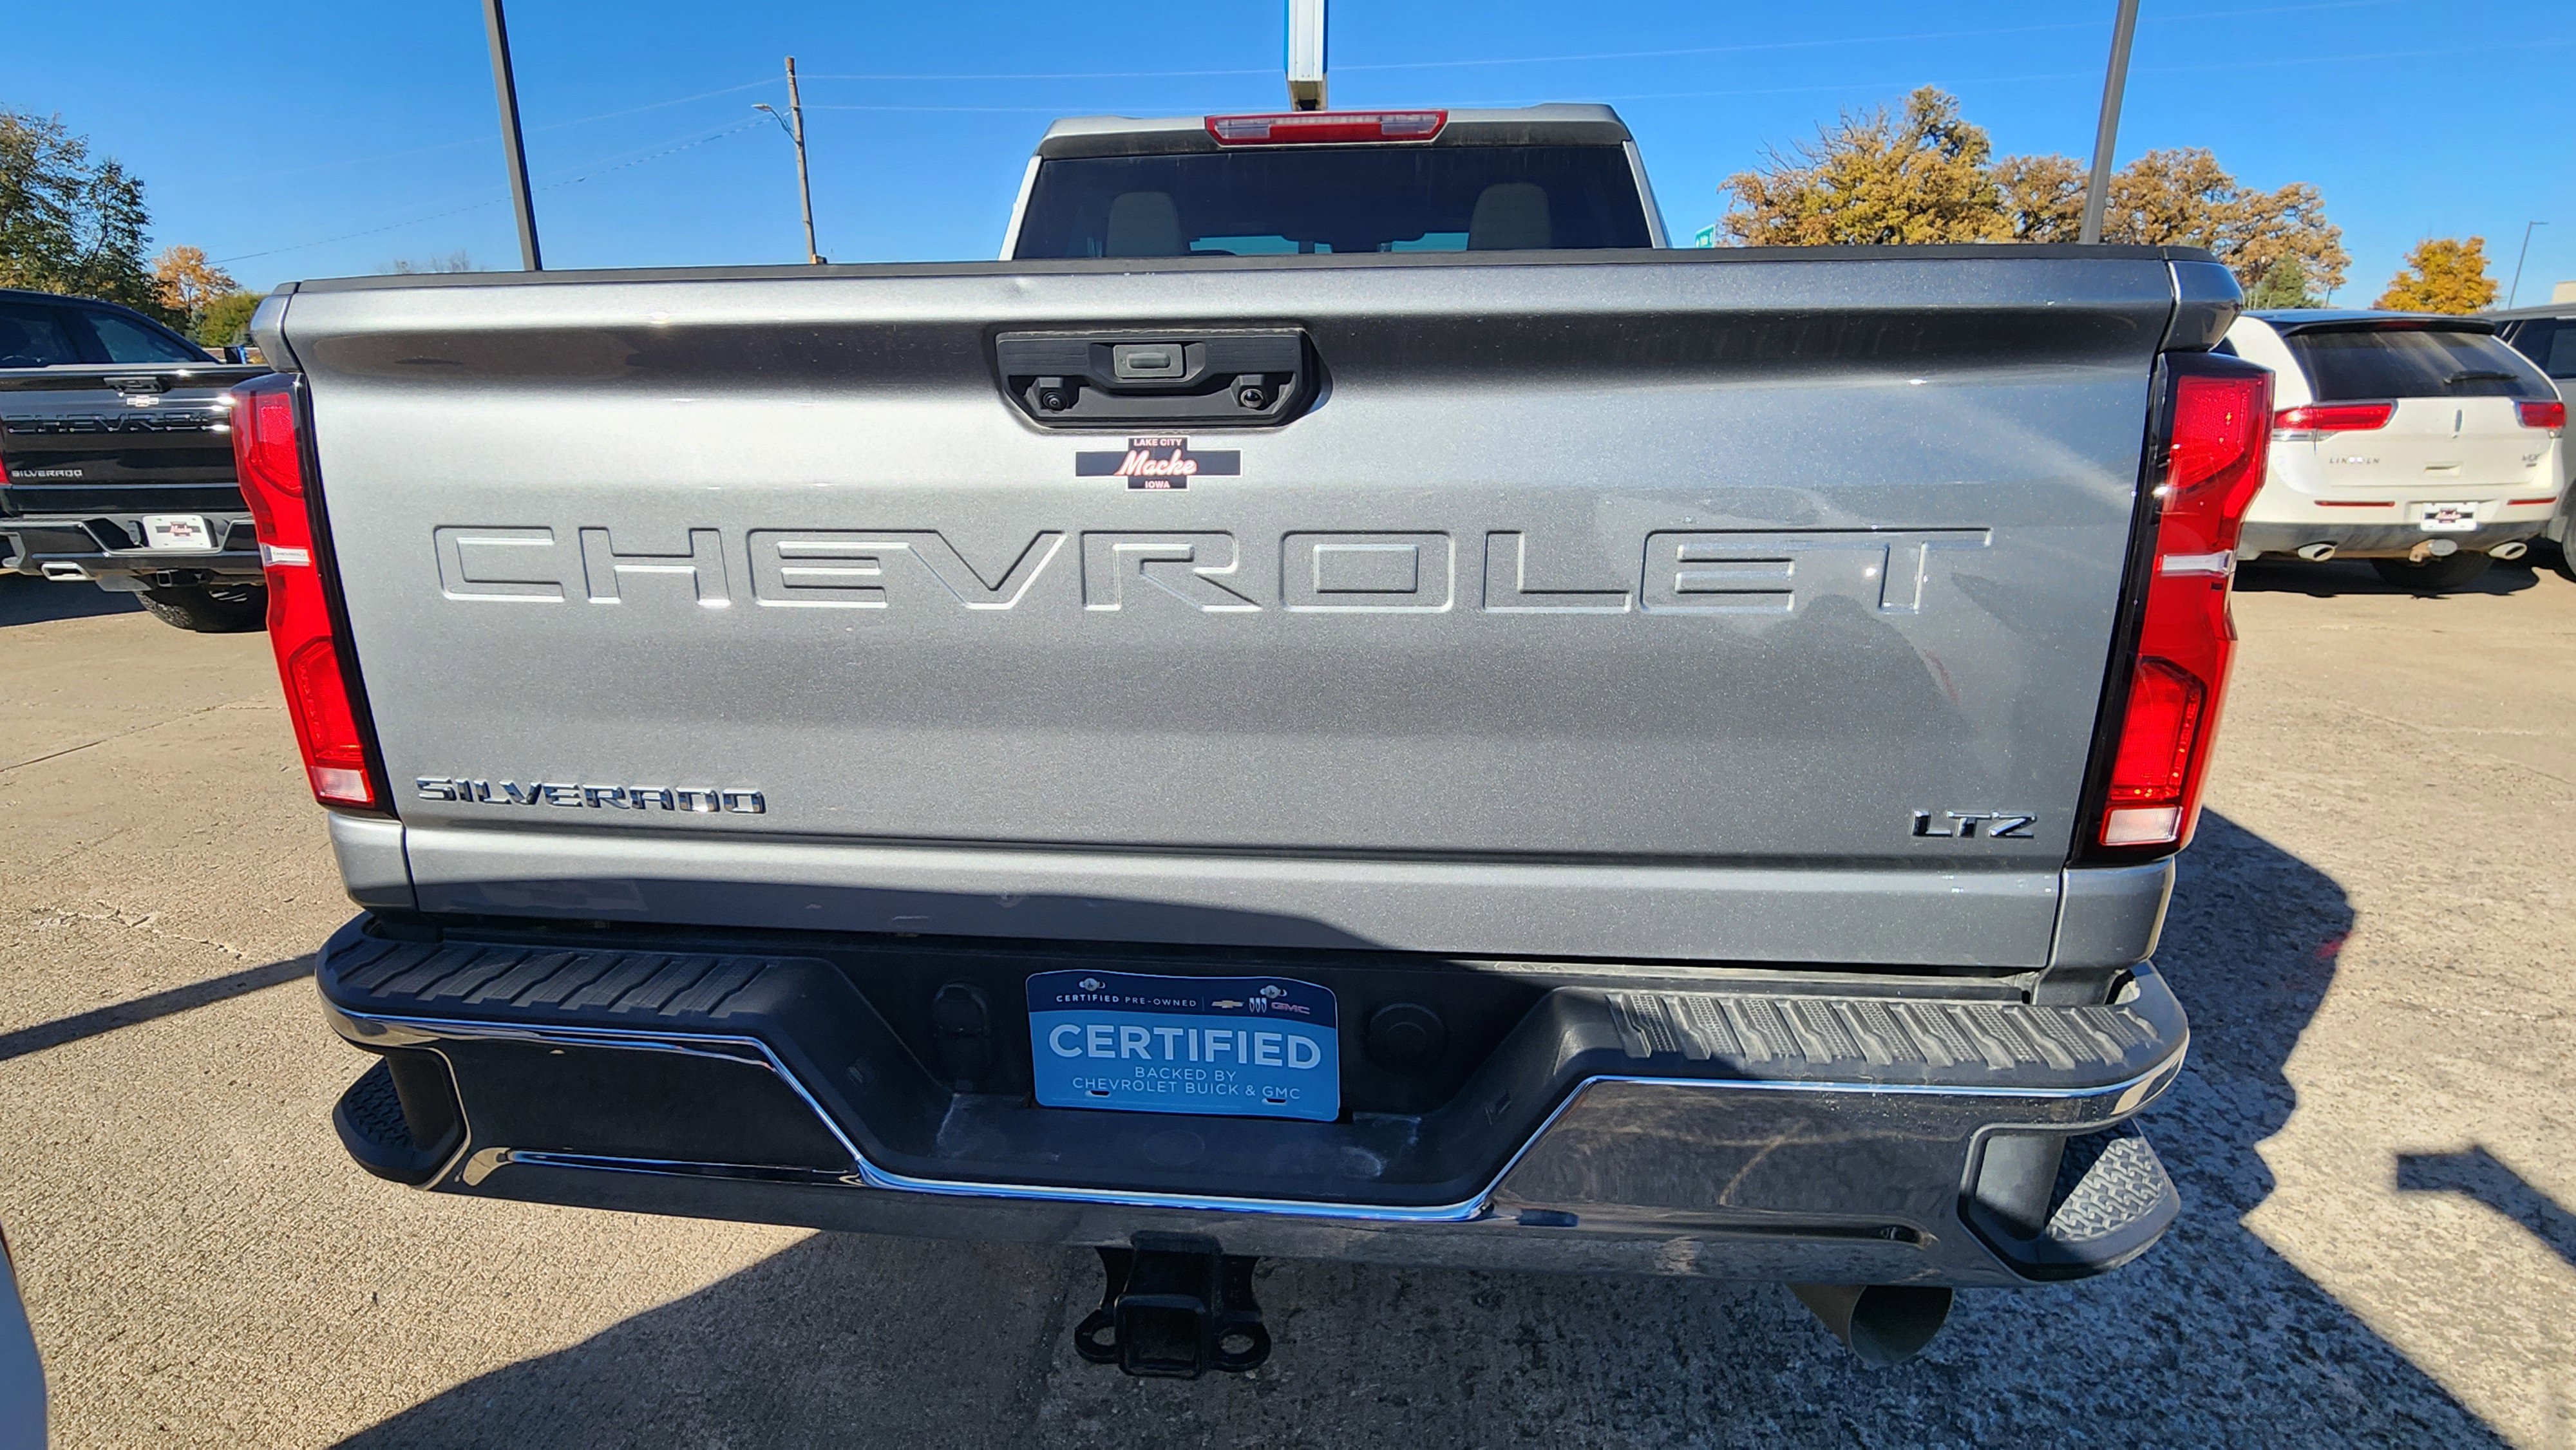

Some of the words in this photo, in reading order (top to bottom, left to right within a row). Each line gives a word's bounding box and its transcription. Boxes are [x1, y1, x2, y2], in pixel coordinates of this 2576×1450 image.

[1114, 449, 1198, 476] Macke
[433, 525, 1993, 615] CHEVROLET
[416, 776, 766, 814] SILVERADO
[1911, 809, 2037, 838] LTZ
[1056, 993, 1119, 1003] CERTIFIED
[1125, 996, 1197, 1007] PRE-OWNED
[1271, 1002, 1310, 1015] GMC
[1049, 1024, 1321, 1069] CERTIFIED
[1135, 1066, 1207, 1081] BACKED
[1215, 1070, 1236, 1082] BY
[1072, 1077, 1178, 1093] CHEVROLET
[1185, 1082, 1239, 1095] BUICK
[1245, 1084, 1256, 1096] &
[1262, 1086, 1301, 1099] GMC
